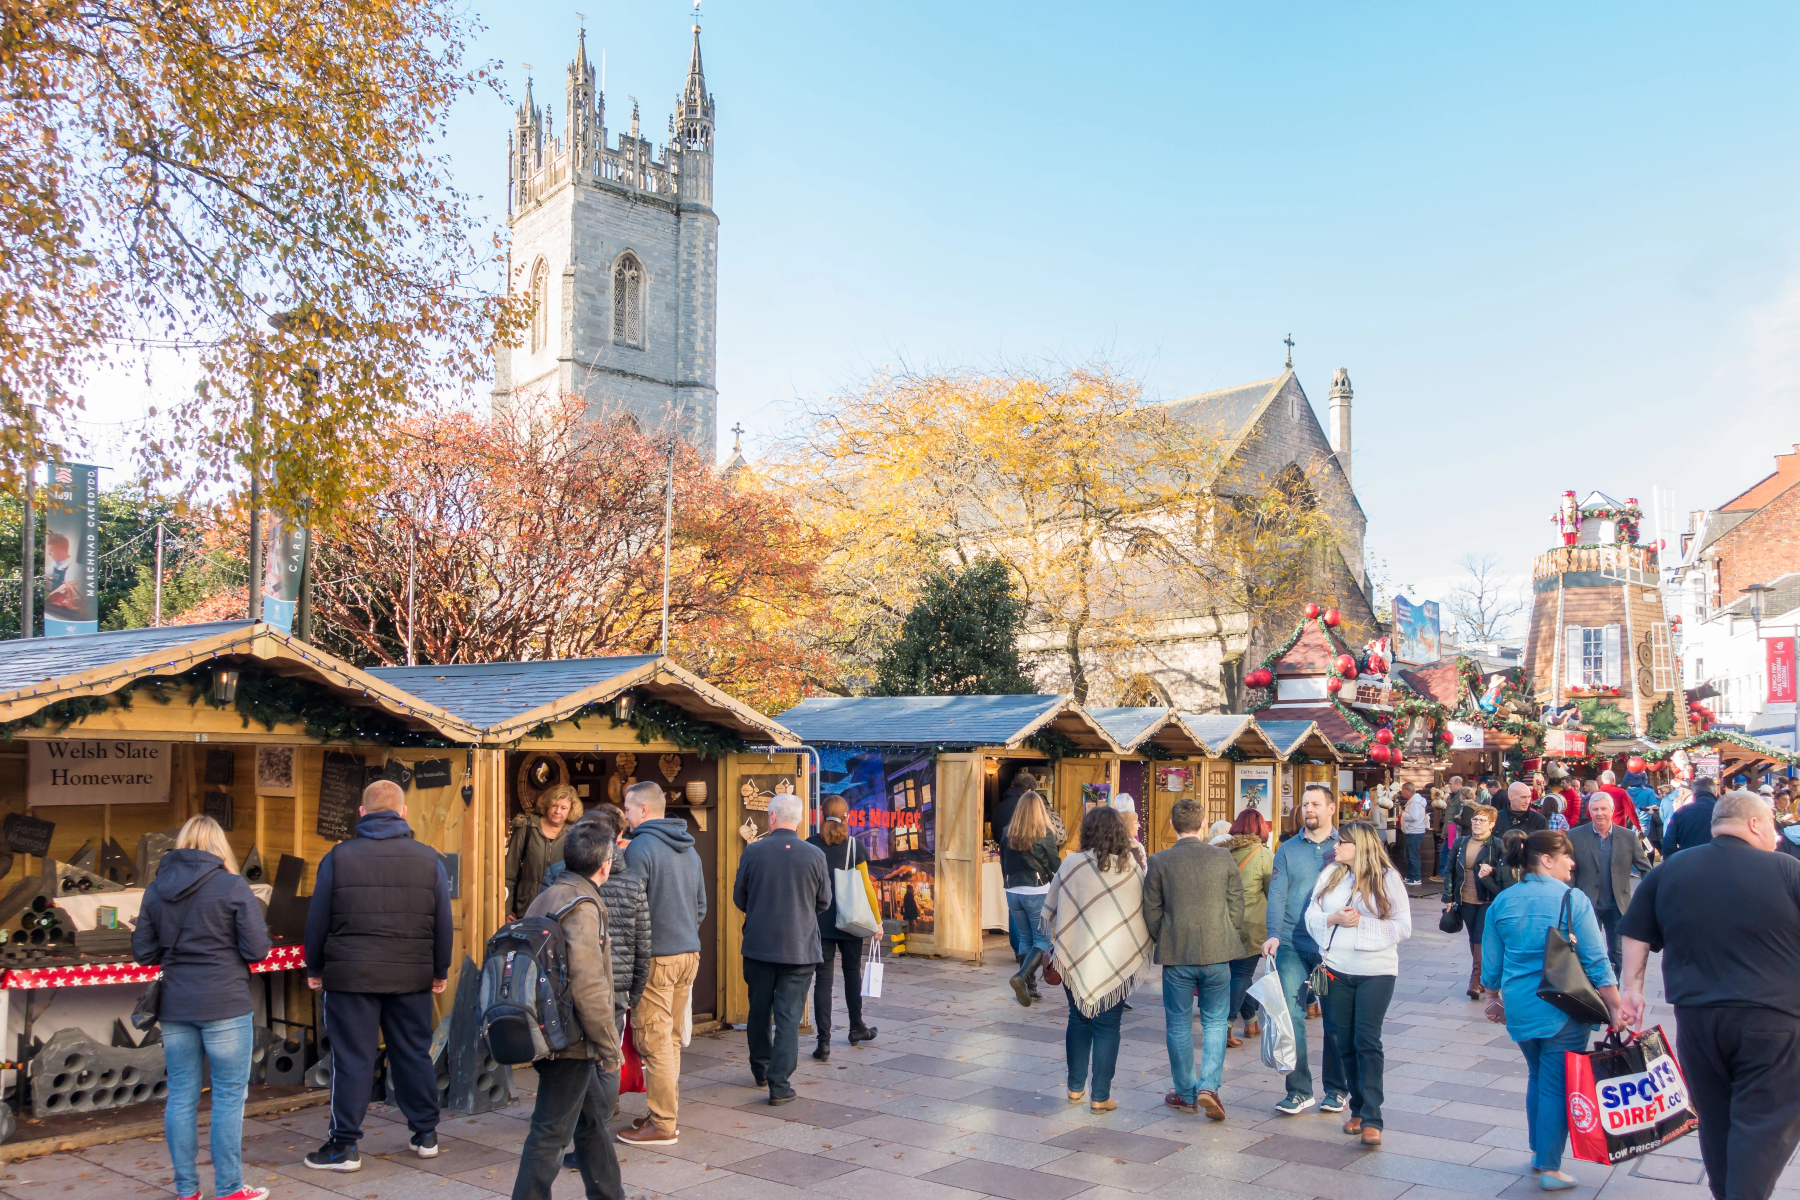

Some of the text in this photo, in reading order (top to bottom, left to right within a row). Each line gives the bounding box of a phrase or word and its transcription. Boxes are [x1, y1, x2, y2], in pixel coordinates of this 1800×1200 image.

[87, 470, 96, 597] MARCHNAD CAERDYDD
[46, 741, 159, 758] Welsh Slate
[50, 768, 153, 785] Homeware
[869, 808, 921, 829] Market
[13, 821, 48, 838] Gardd
[7, 832, 46, 851] Mamgu
[1609, 1147, 1628, 1161] LOW
[1629, 1139, 1661, 1153] PRICES
